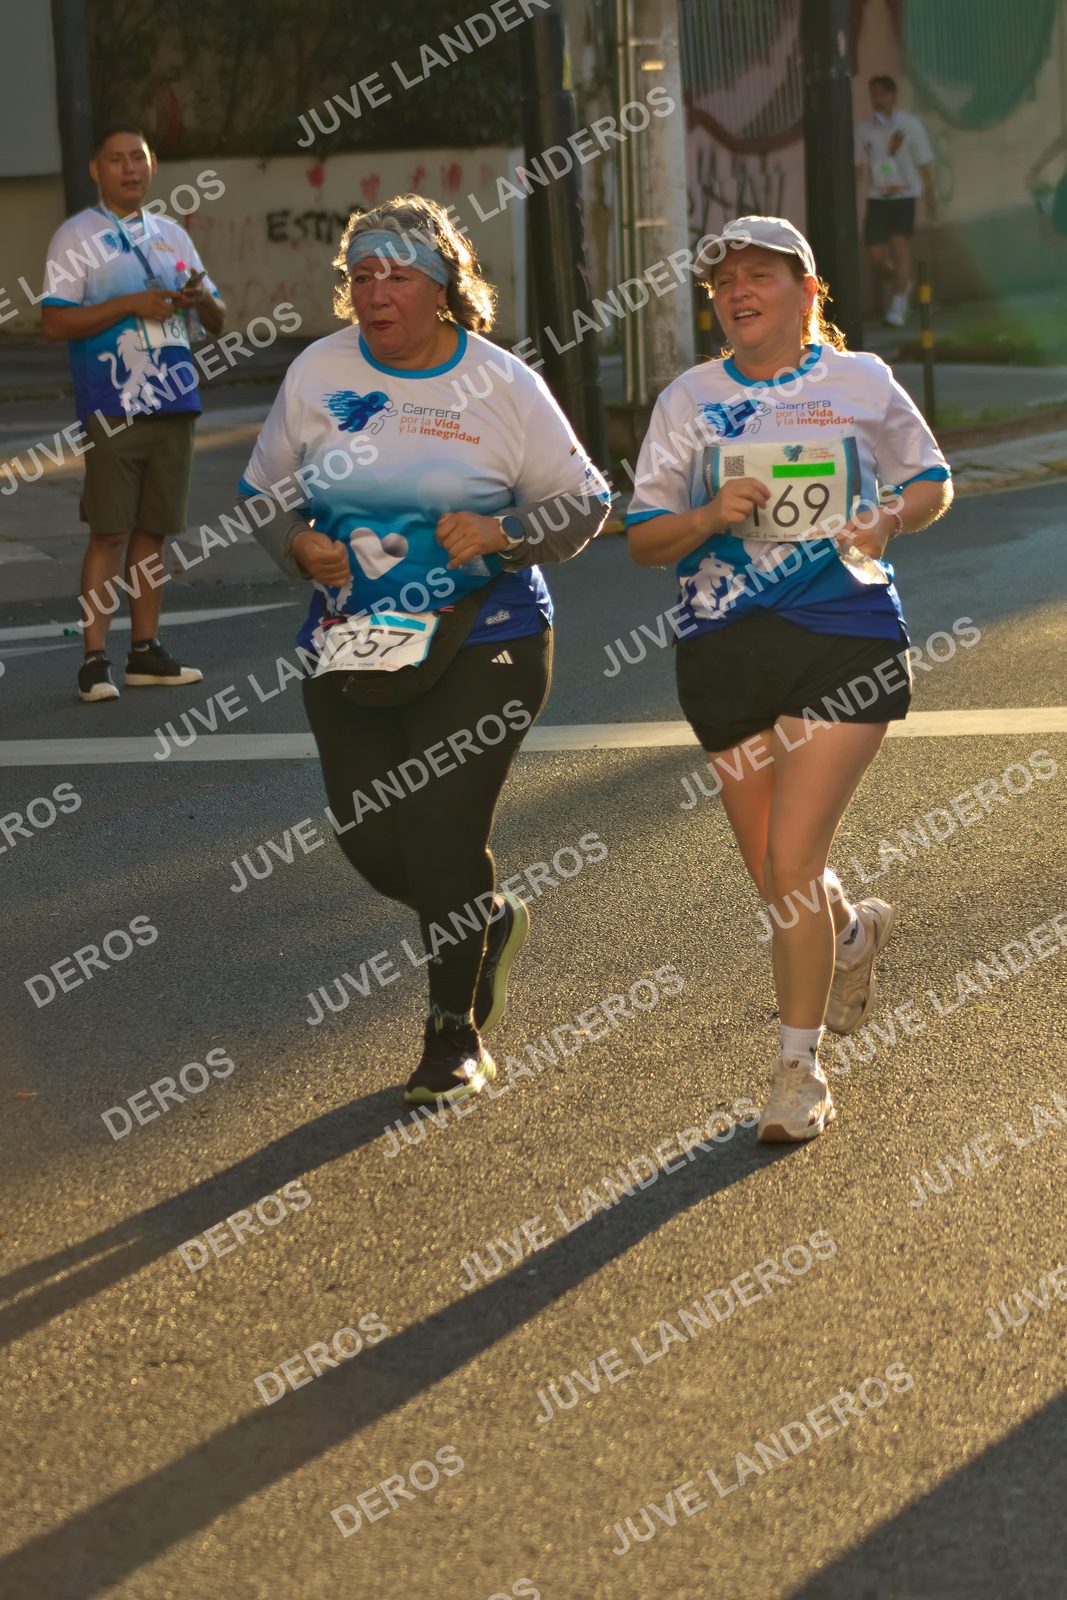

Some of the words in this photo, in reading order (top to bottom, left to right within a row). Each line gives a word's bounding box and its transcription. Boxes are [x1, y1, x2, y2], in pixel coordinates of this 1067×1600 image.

[402, 403, 461, 420] Carrera
[775, 400, 831, 410] Carrera
[776, 411, 793, 420] por
[796, 409, 806, 417] la
[808, 409, 833, 417] Vida
[784, 417, 794, 425] la
[797, 416, 855, 426] Integridad
[400, 415, 418, 425] por
[421, 416, 431, 425] la
[434, 418, 460, 430] Vida
[407, 424, 417, 434] la
[420, 427, 480, 445] Integridad
[330, 628, 415, 661] 757
